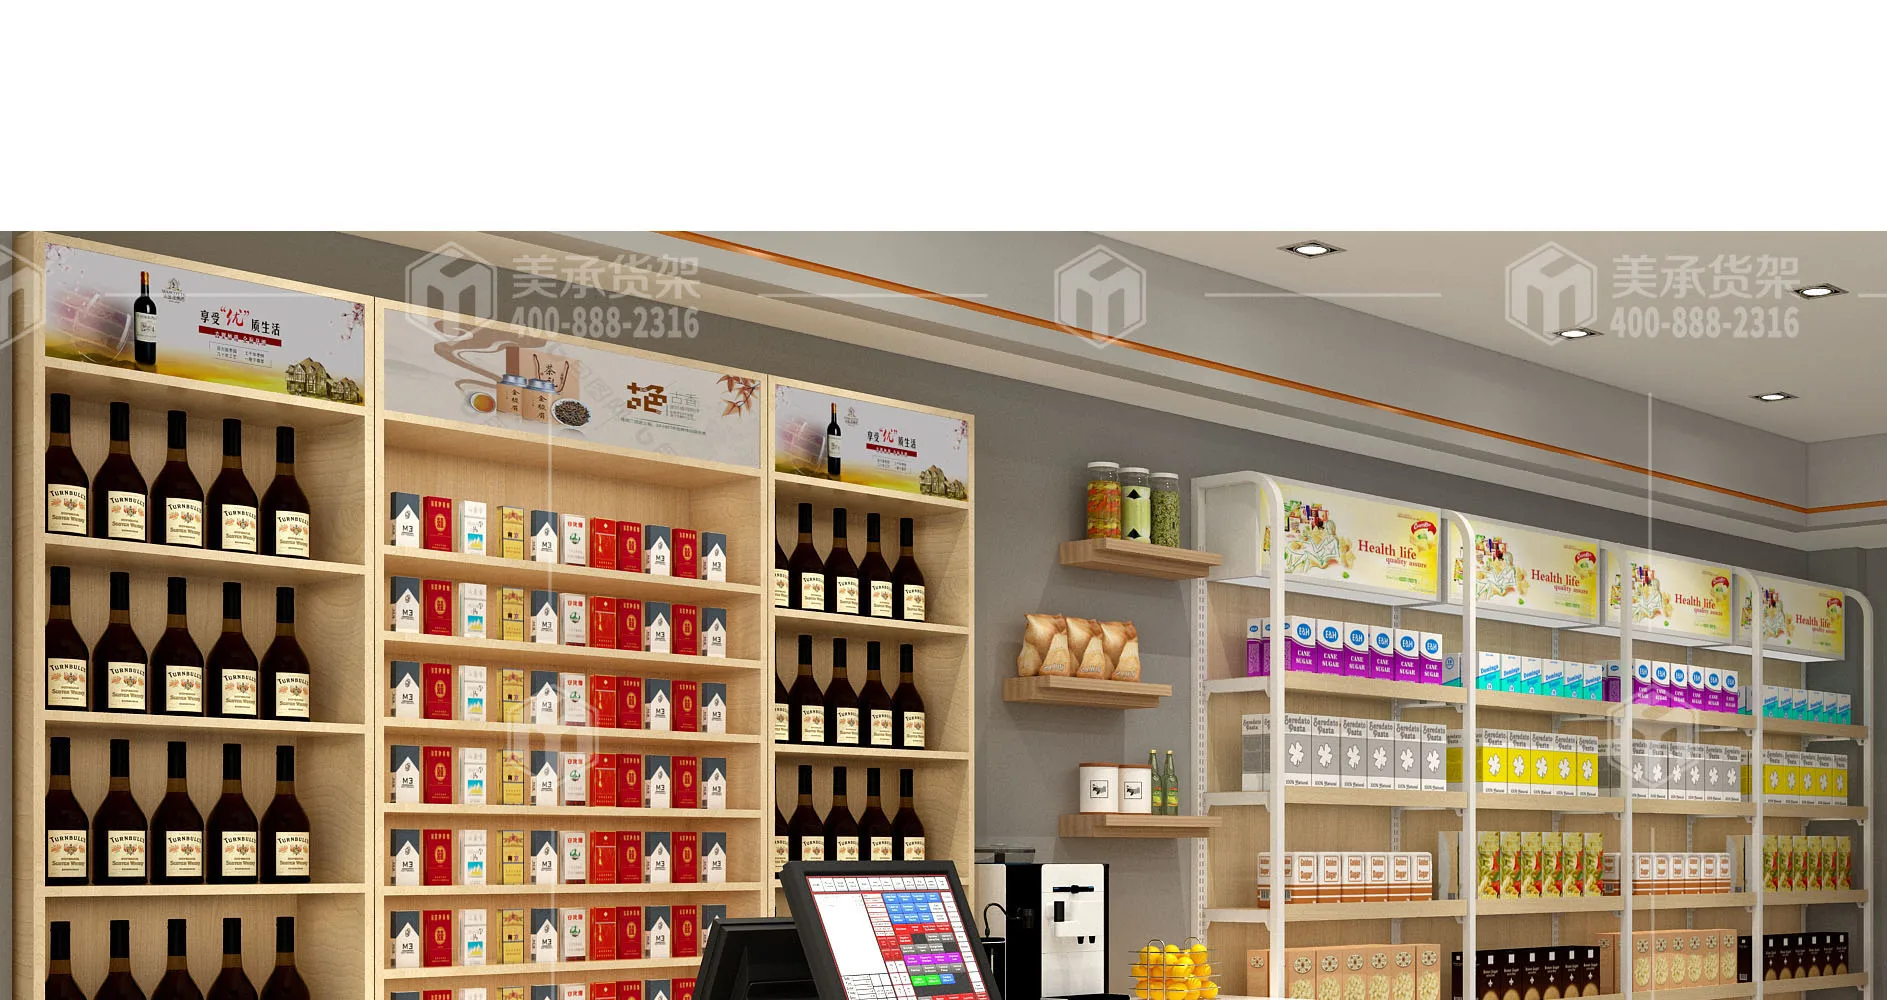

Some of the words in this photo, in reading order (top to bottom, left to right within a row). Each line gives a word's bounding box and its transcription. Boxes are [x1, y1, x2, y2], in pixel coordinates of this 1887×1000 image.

[402, 525, 414, 533] M3
[542, 541, 552, 549] M3
[1358, 539, 1395, 557] Health
[1400, 546, 1416, 560] life
[655, 554, 666, 562] M3
[712, 561, 722, 569] M3
[1386, 558, 1407, 567] quality
[1531, 569, 1563, 584] Health
[1565, 574, 1580, 587] life
[1675, 593, 1701, 608] Health
[1703, 598, 1716, 610] life
[402, 608, 414, 617] M3
[542, 621, 552, 629] M3
[1795, 614, 1818, 627] Health
[1820, 618, 1831, 628] life
[712, 637, 722, 645] M3
[1350, 655, 1364, 663] CANE
[1375, 665, 1390, 673] SUGAR
[402, 693, 414, 702] M3
[712, 711, 722, 719] M3
[1291, 725, 1305, 733] Pasta
[1317, 727, 1334, 735] Pasta
[1373, 730, 1389, 738] Pasta
[1400, 732, 1416, 740] Pasta
[402, 777, 414, 785] M3
[655, 784, 666, 792] M3
[402, 860, 414, 868] M3
[542, 860, 552, 868] M3
[712, 860, 722, 868] M3
[655, 935, 666, 943] M3
[402, 943, 414, 951] M3
